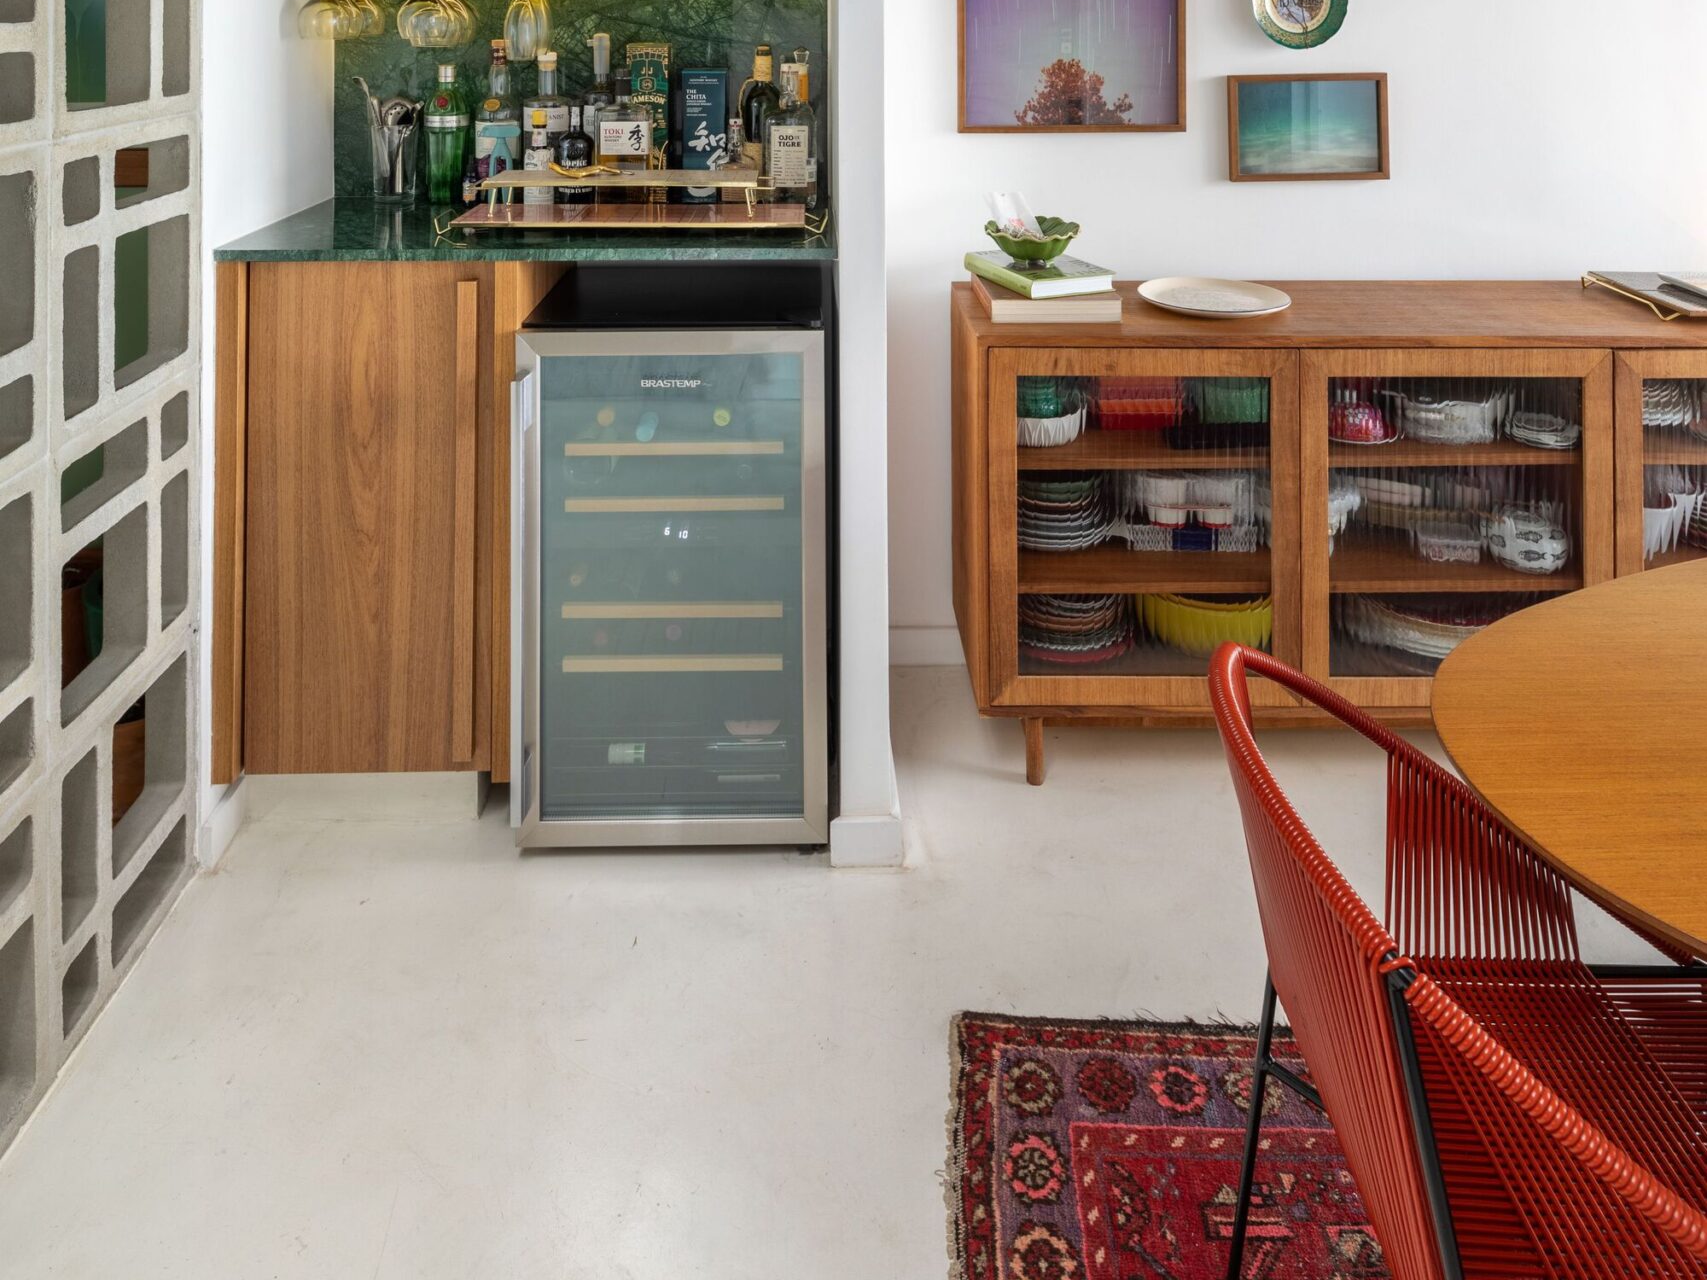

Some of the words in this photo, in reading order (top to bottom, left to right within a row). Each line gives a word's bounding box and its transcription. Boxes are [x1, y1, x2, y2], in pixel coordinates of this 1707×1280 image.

[631, 95, 666, 104] AMESON
[641, 380, 701, 388] BRASTEMP
[664, 527, 670, 535] 6
[679, 530, 688, 539] 10
